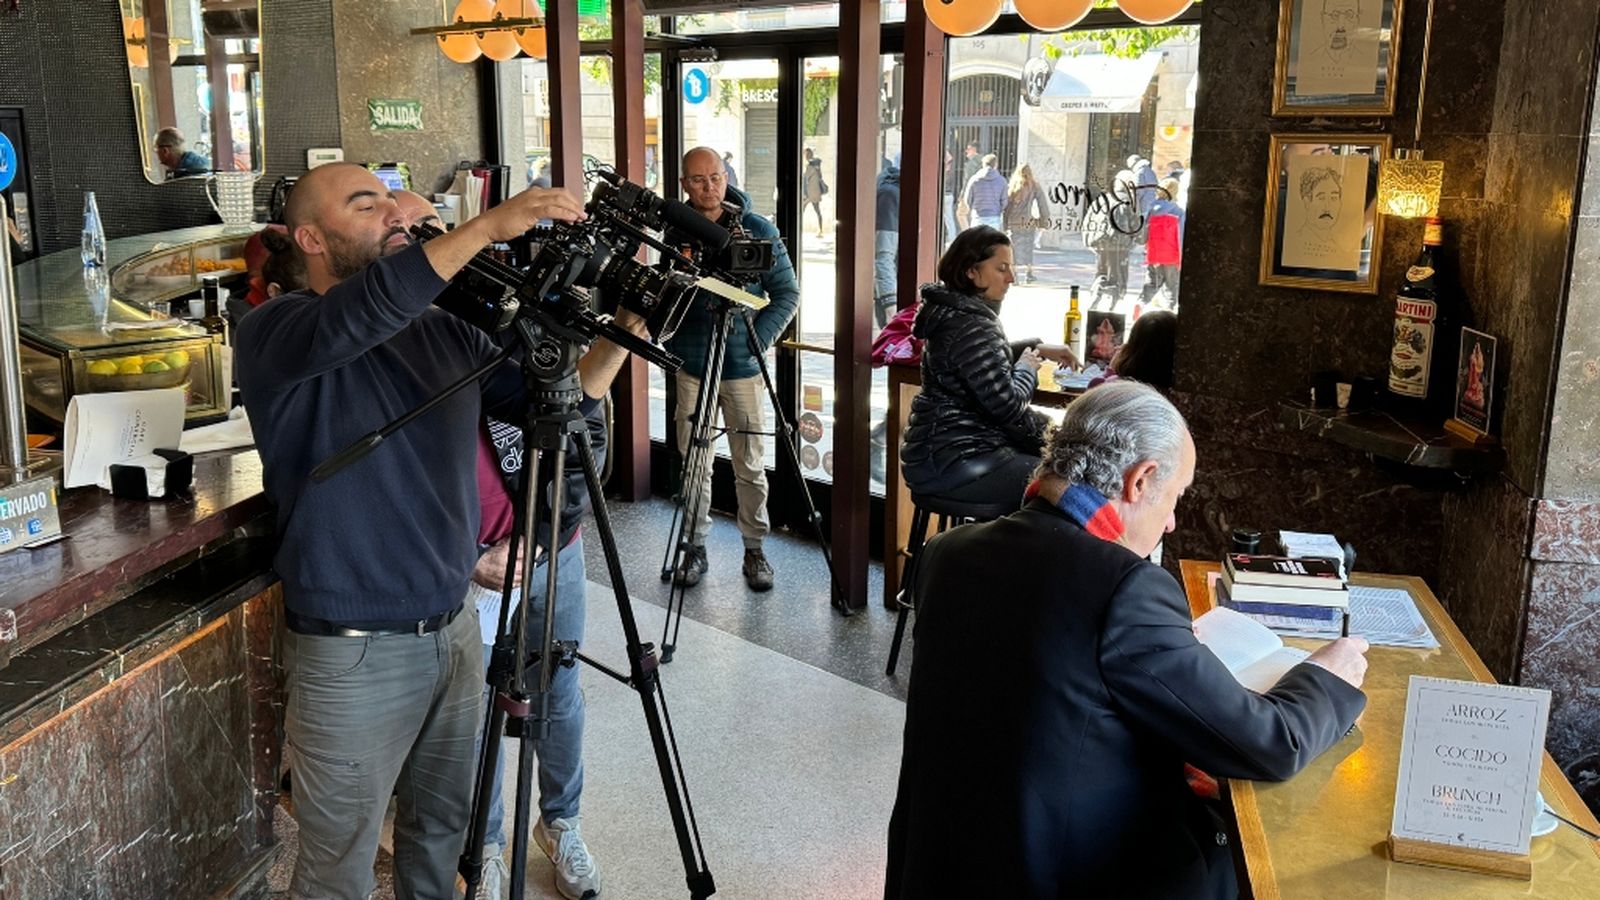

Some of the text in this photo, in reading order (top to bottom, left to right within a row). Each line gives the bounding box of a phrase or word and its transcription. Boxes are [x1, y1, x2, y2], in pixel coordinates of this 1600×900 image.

[374, 105, 417, 126] SALIDA
[1447, 703, 1508, 722] ARROZ
[1435, 744, 1508, 765] COCIDO
[1432, 784, 1501, 805] BRUNCH
